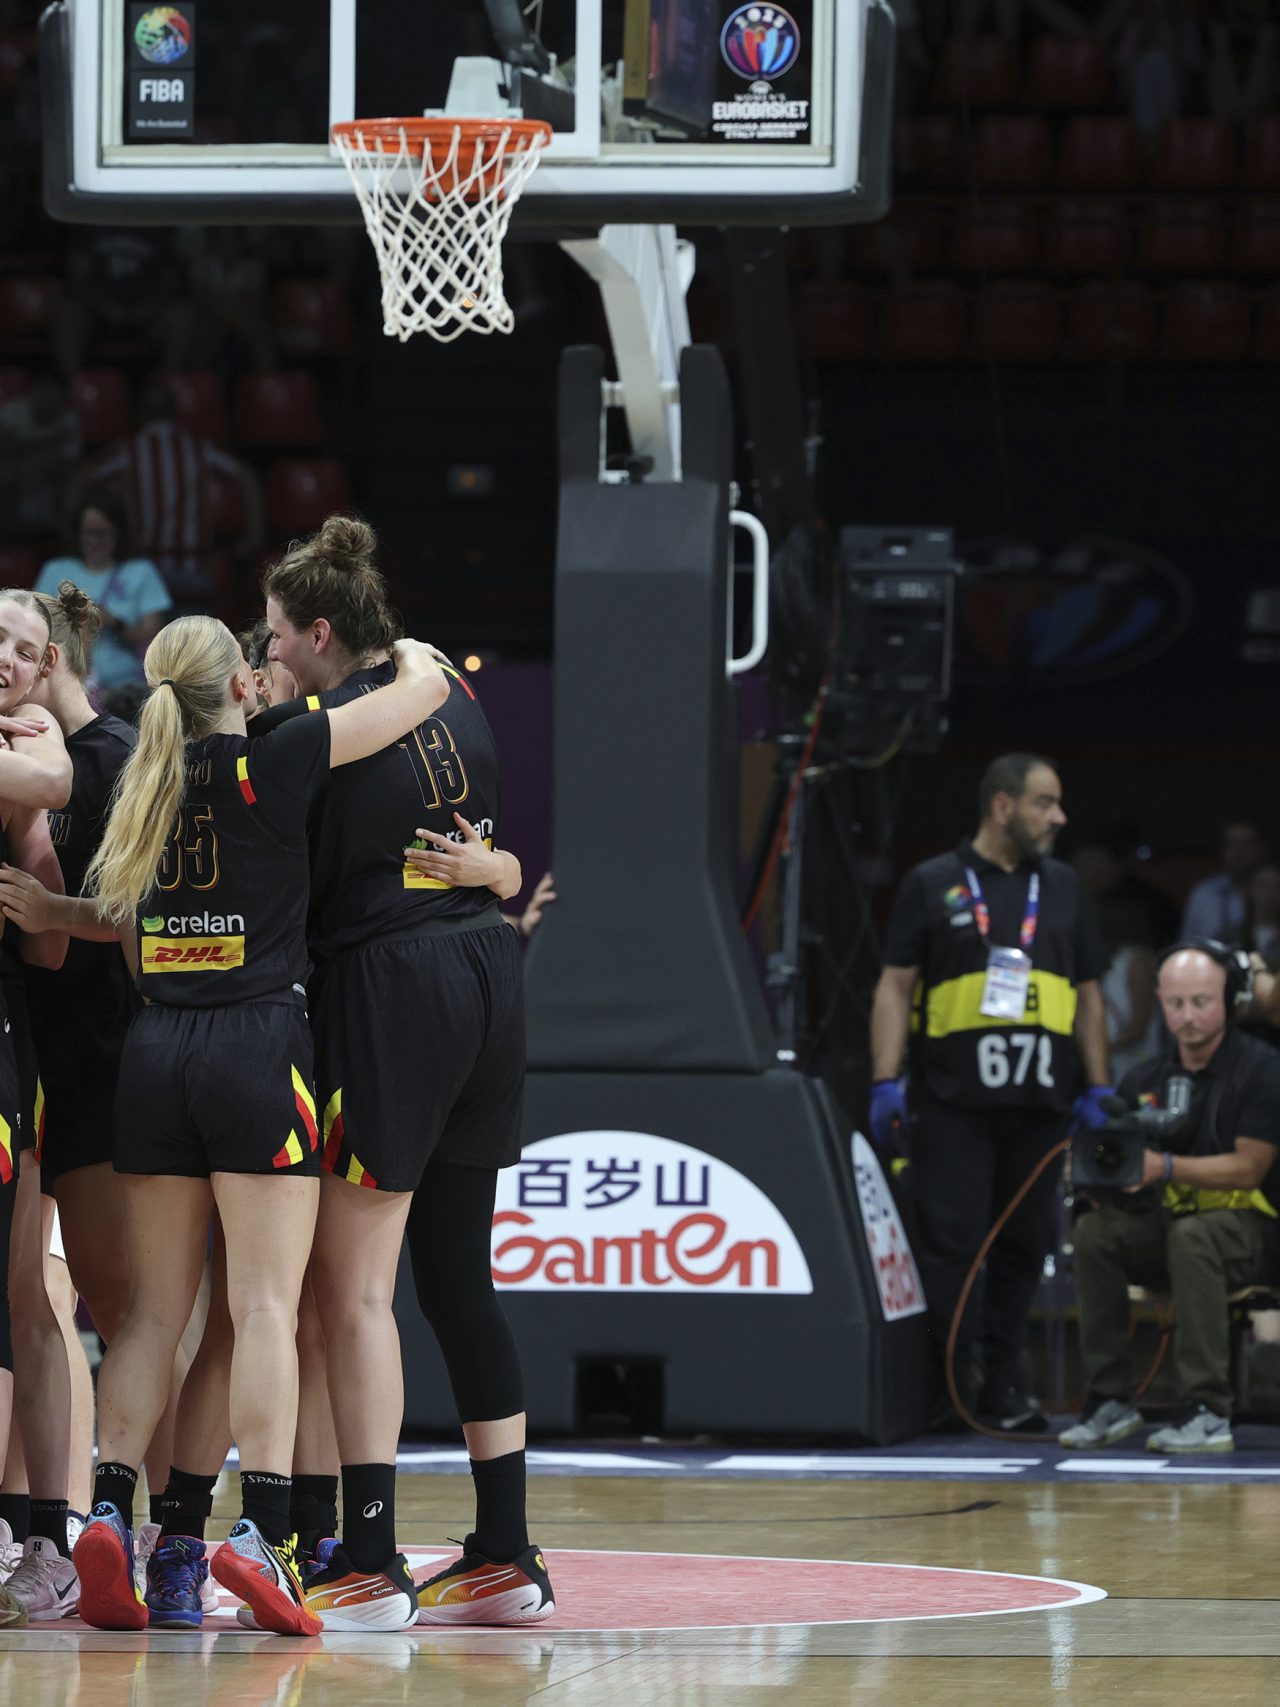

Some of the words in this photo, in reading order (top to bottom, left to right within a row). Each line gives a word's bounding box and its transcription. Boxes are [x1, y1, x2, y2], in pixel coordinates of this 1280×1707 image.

[140, 79, 185, 102] FIBA
[712, 100, 809, 120] EUROBASKET
[397, 716, 470, 810] 13
[160, 802, 221, 891] 35
[167, 910, 245, 935] crelan
[149, 945, 233, 964] DHL
[518, 1158, 710, 1210] 百岁山
